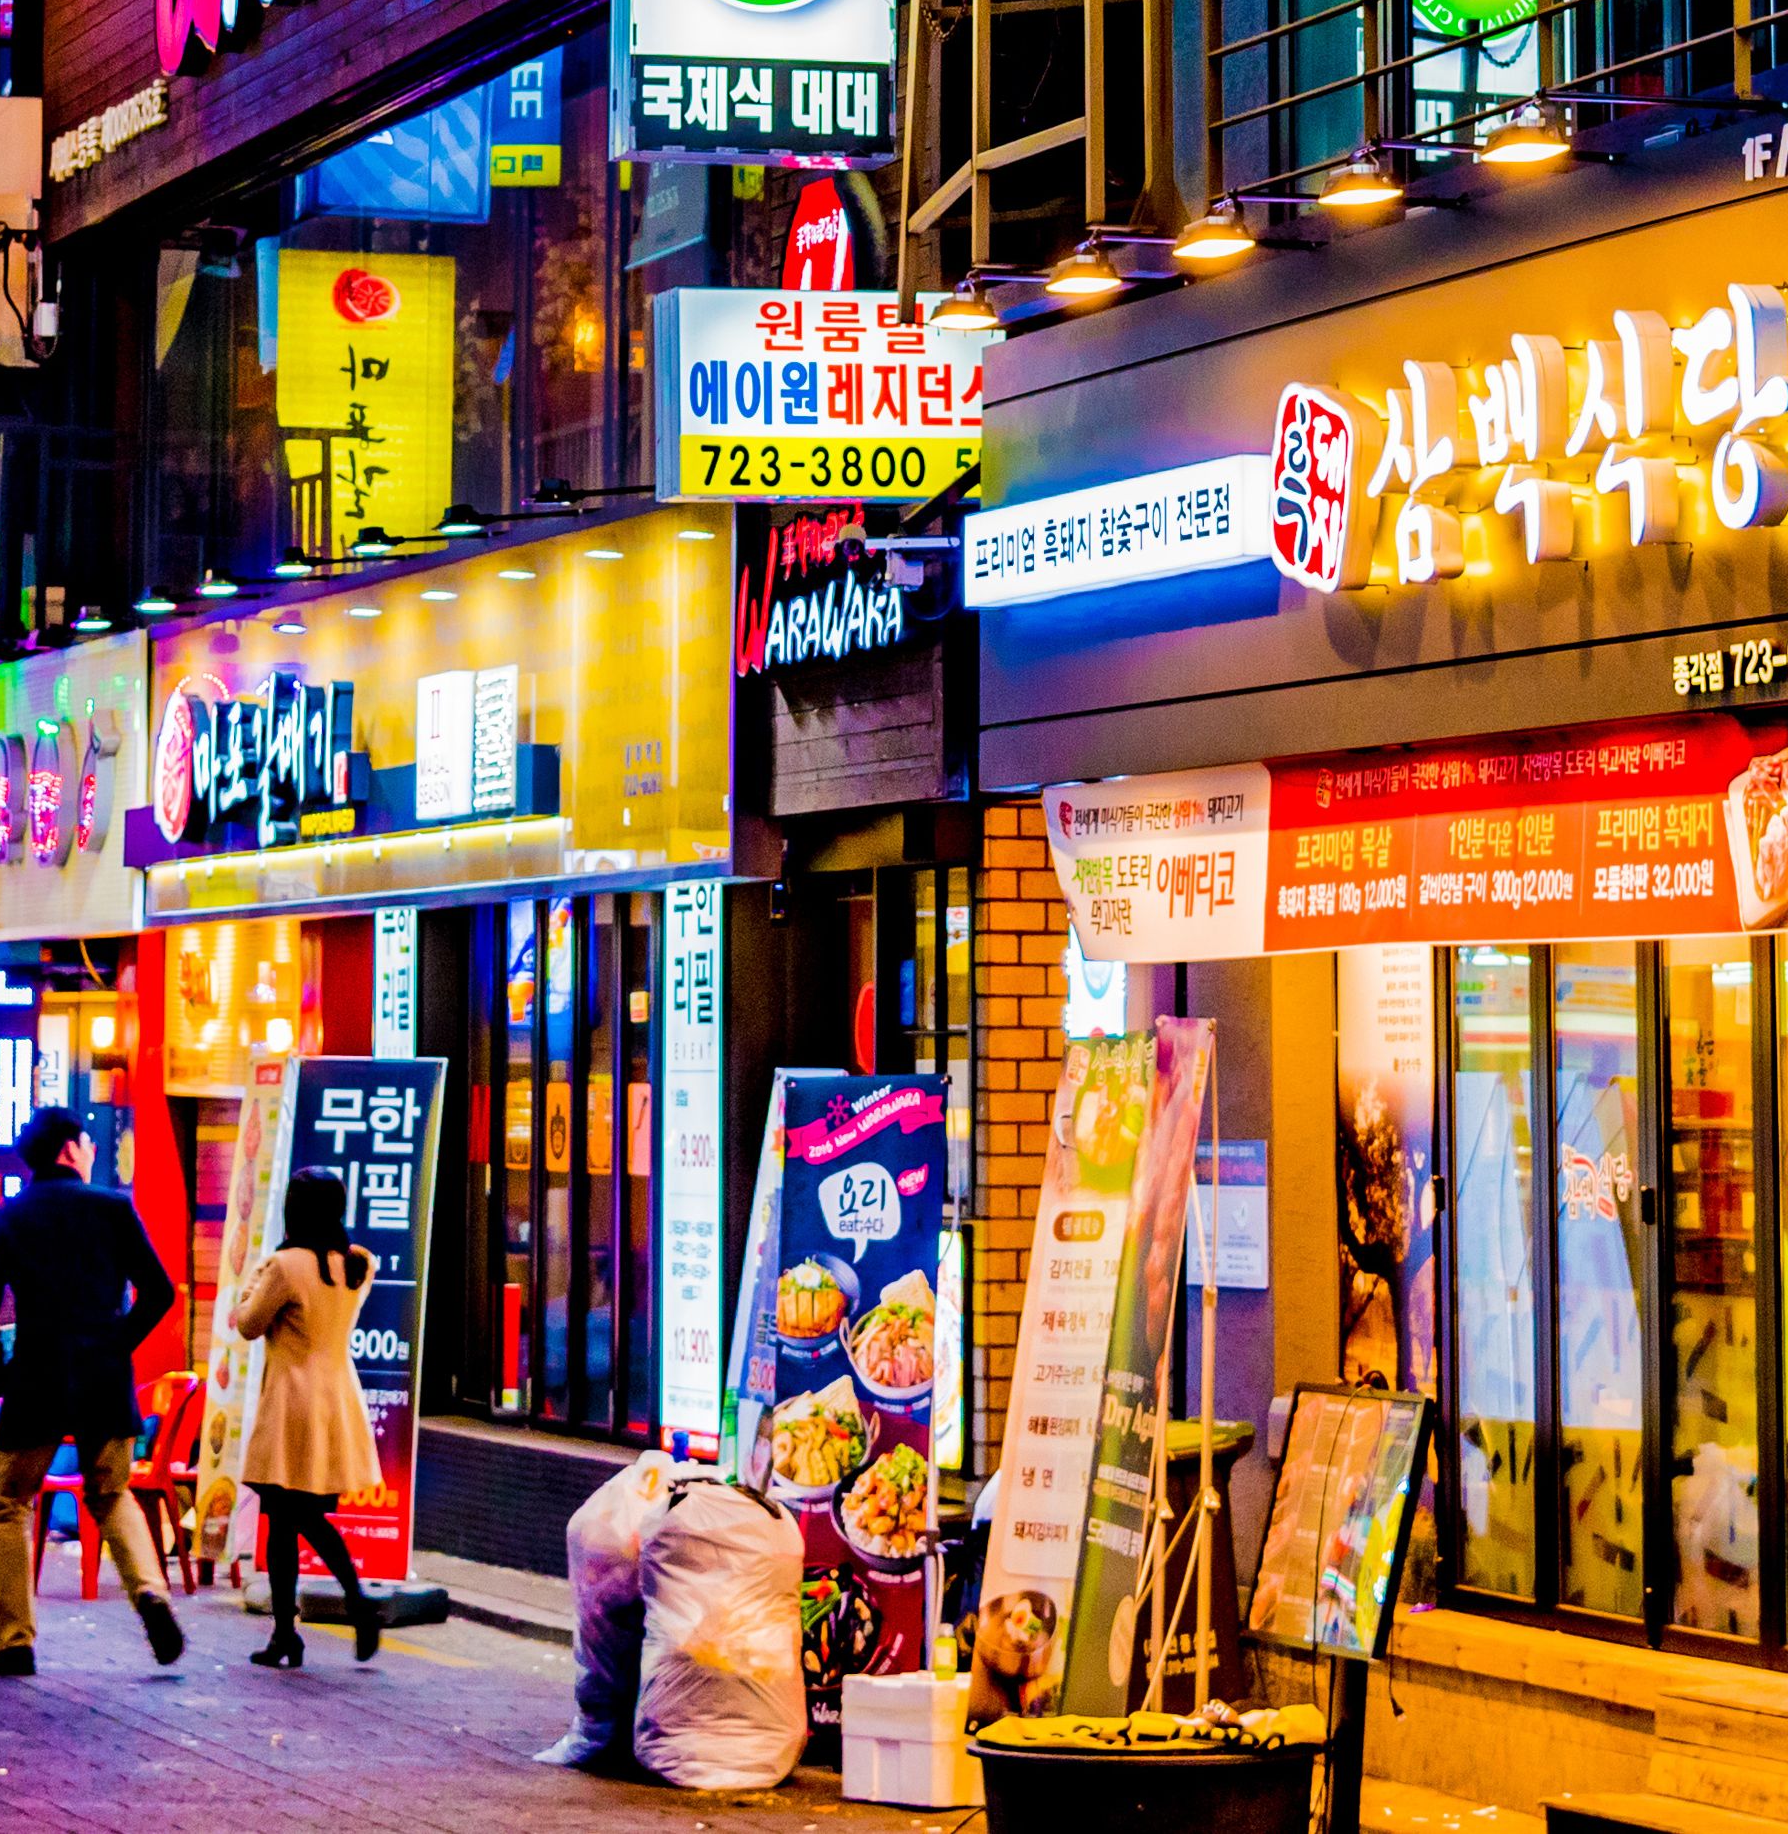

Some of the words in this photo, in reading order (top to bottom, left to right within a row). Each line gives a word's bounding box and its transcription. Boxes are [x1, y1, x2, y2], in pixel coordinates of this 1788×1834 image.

[642, 64, 774, 134] 국제식
[790, 69, 879, 137] 대대
[700, 445, 926, 487] 723-3800
[973, 527, 1036, 583] 프리미엄
[1042, 512, 1093, 570] 흑돼지
[1099, 498, 1169, 562] 참숯구이
[1176, 482, 1232, 547] 전문점
[735, 526, 904, 678] WARAWARA
[1672, 646, 1724, 695] 종각점
[1564, 748, 1597, 778] 도토리
[1642, 739, 1686, 771] 이베리코
[1145, 801, 1172, 830] 극찬한
[1207, 793, 1244, 825] 돼지고기
[1595, 806, 1661, 852] 프리미엄
[1663, 802, 1714, 849] 흑돼지
[1295, 828, 1355, 872] 프리미엄
[1360, 826, 1393, 869] 목살
[1447, 816, 1486, 861] 1인분
[1516, 812, 1556, 856] 1인분
[1116, 853, 1153, 891] 도토리
[1156, 851, 1236, 919] 이베리코
[1419, 872, 1464, 908] 갈비양념
[1464, 871, 1487, 904] 구이
[1490, 869, 1522, 910] 300g
[1522, 868, 1574, 907] 12,000원
[1592, 863, 1649, 903] 모둠한판
[1651, 859, 1715, 902] 32,000원
[1338, 882, 1363, 915] 180g
[1363, 874, 1408, 911] 12,000원
[673, 945, 714, 1025] 리필
[314, 1087, 423, 1152] 무한
[850, 1083, 893, 1115] Winter
[808, 1138, 834, 1159] 2016
[838, 1173, 887, 1218] 요리
[897, 1167, 927, 1190] NEW
[1049, 1258, 1093, 1280] 김치전골
[1103, 1393, 1133, 1437] Dry
